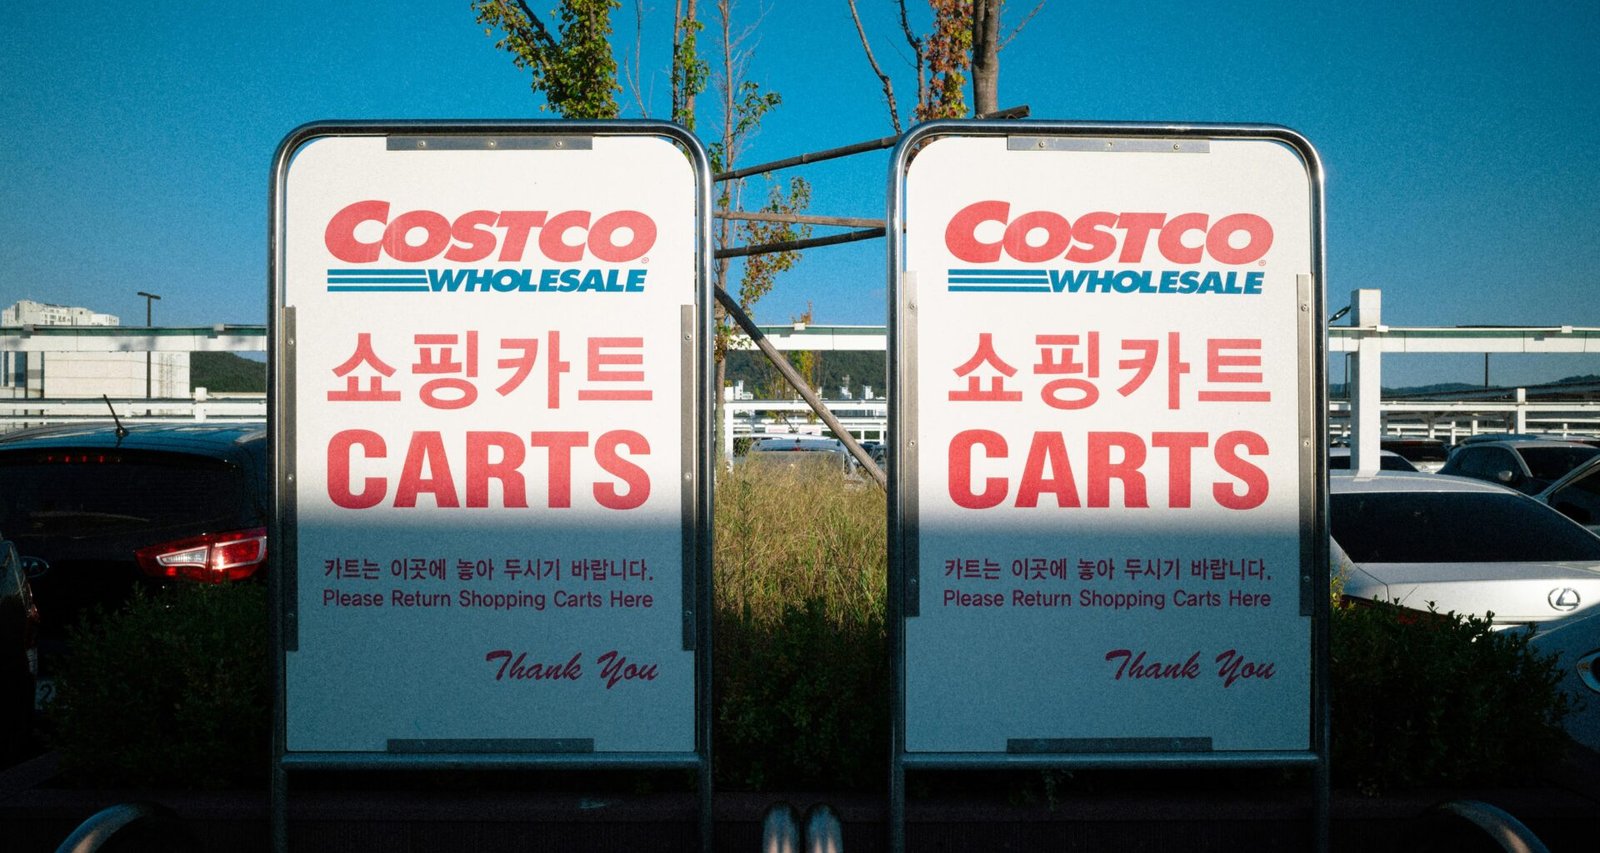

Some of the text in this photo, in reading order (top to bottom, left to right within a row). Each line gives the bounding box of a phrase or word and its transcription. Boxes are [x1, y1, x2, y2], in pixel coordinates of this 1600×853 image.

[324, 199, 658, 264] COSTCO
[944, 199, 1274, 266] COSTCO
[427, 269, 648, 292] WHOLESALE
[1047, 270, 1264, 294] WHOLESALE
[327, 330, 653, 410] 쇼핑카트
[948, 330, 1271, 410] 쇼핑카트
[326, 429, 652, 510] CARTS
[947, 429, 1270, 510] CARTS
[324, 557, 654, 582] 카트는 이곳에 놓아 두시기 바랍니다.
[944, 557, 1272, 581] 카트는 이곳에 놓아 두시기 바랍니다.
[322, 589, 654, 612] Please Return Shopping Carts Here
[943, 589, 1271, 611] Please Return Shopping Carts Here
[484, 649, 658, 689] Thank You
[1104, 648, 1275, 688] Thank You
